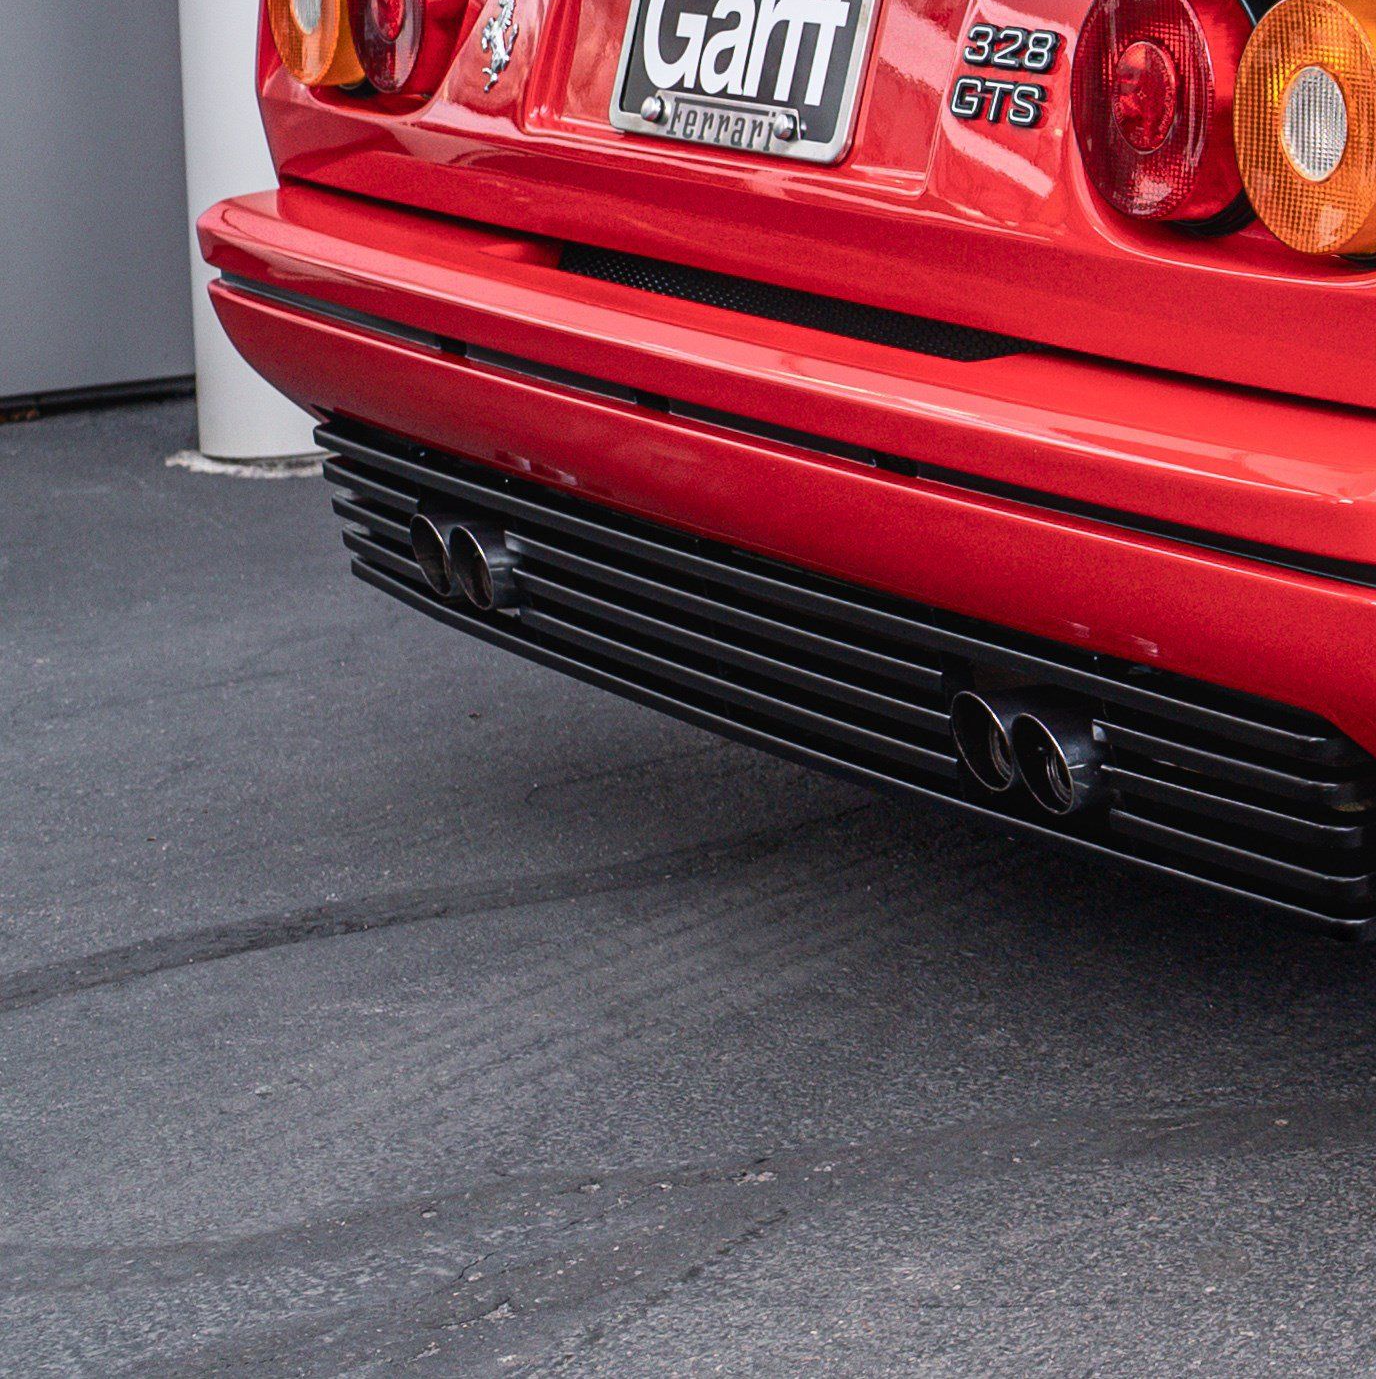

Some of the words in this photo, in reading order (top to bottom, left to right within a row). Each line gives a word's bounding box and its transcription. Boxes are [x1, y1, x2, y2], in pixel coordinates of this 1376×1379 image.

[962, 23, 1059, 72] 328
[666, 96, 776, 152] Ferrari
[950, 75, 1045, 126] GTS
